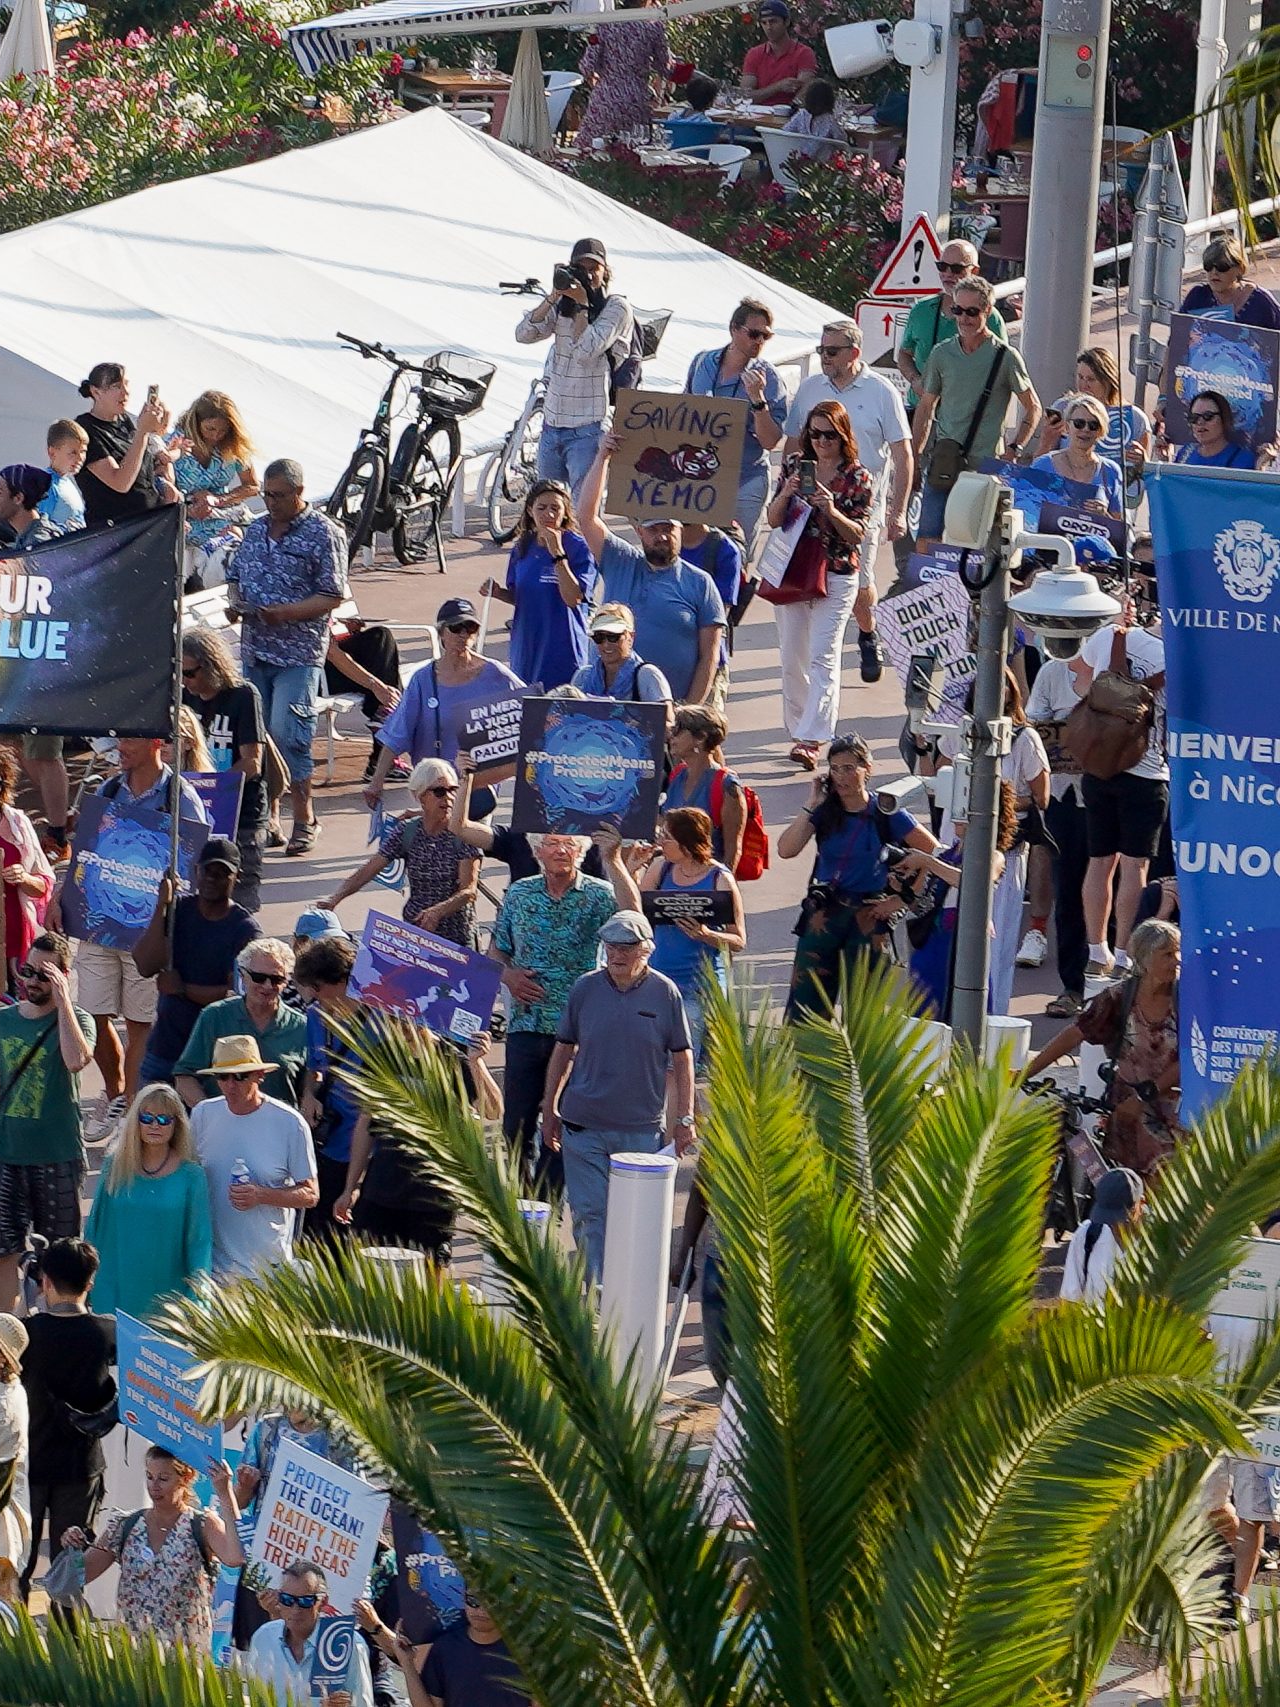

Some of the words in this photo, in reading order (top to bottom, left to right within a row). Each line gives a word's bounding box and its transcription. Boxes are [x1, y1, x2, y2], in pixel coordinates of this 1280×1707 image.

[624, 401, 733, 438] SAVING
[626, 479, 717, 512] NEMO
[1061, 518, 1108, 538] DROITS
[895, 592, 947, 626] DON'T
[1166, 607, 1230, 629] VILLE
[1235, 611, 1267, 632] DE
[900, 612, 961, 648] TOUCH
[465, 720, 484, 735] LA
[470, 705, 489, 720] EN
[473, 741, 519, 762] PALOU
[525, 750, 656, 770] #ProtectedMeans
[1167, 731, 1280, 764] IENVE
[553, 765, 626, 781] Protected
[1188, 771, 1210, 801] à
[1221, 774, 1280, 807] Nic
[99, 869, 160, 896] Protecte
[1211, 1040, 1232, 1054] DES
[1233, 1042, 1278, 1058] NATIOS
[162, 1375, 200, 1402] STAKE
[284, 1459, 352, 1509] PROTECT
[280, 1479, 310, 1509] THE
[310, 1496, 365, 1539] OCEAN!
[272, 1501, 328, 1542] RATIFY
[329, 1530, 360, 1561] THE
[268, 1522, 310, 1556] HIGH
[312, 1545, 350, 1578] SEAS
